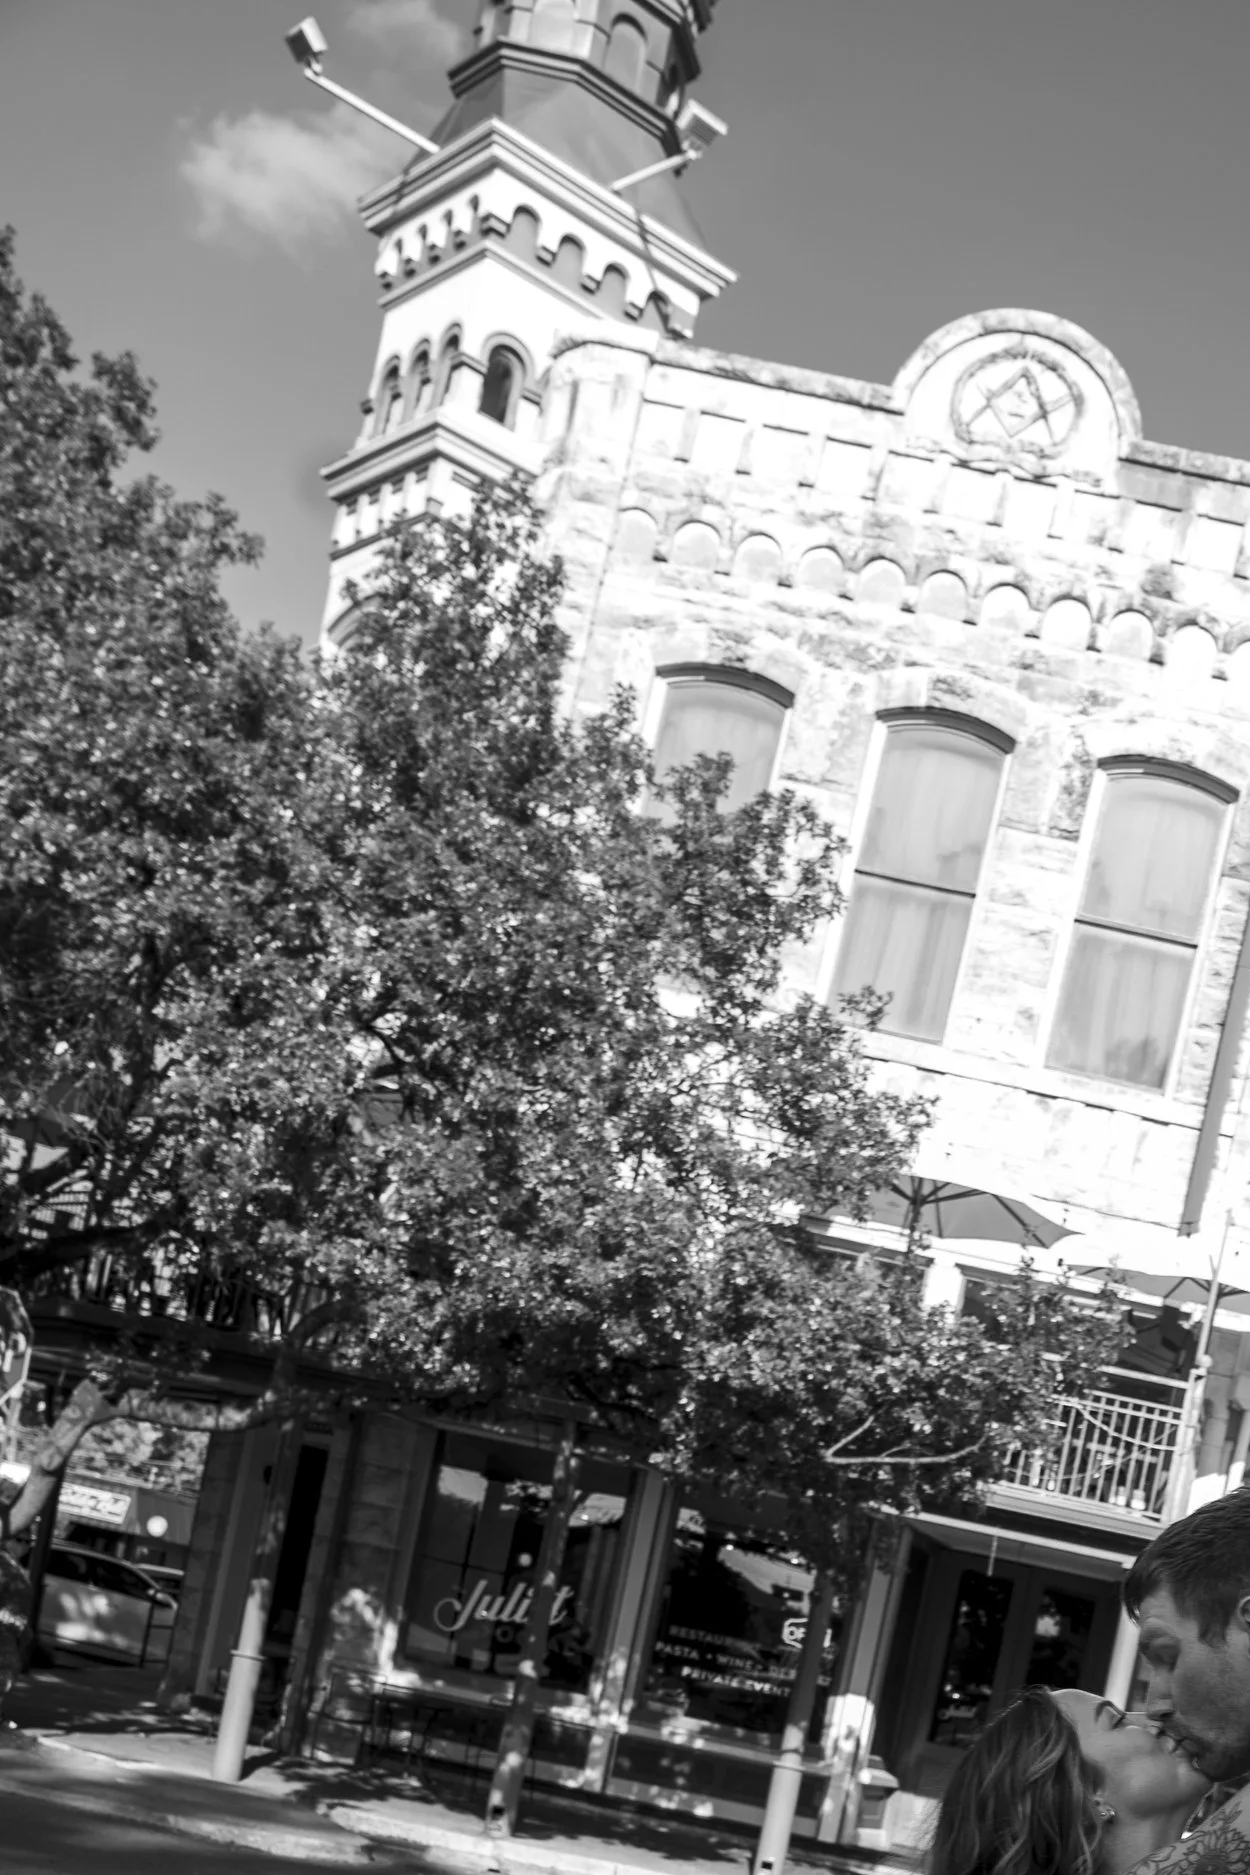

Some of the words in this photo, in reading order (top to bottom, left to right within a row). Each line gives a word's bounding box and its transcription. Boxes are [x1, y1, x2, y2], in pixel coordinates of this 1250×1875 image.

[434, 1579, 575, 1631] Julit
[655, 1641, 700, 1660] PASTA
[716, 1653, 754, 1671] WINE
